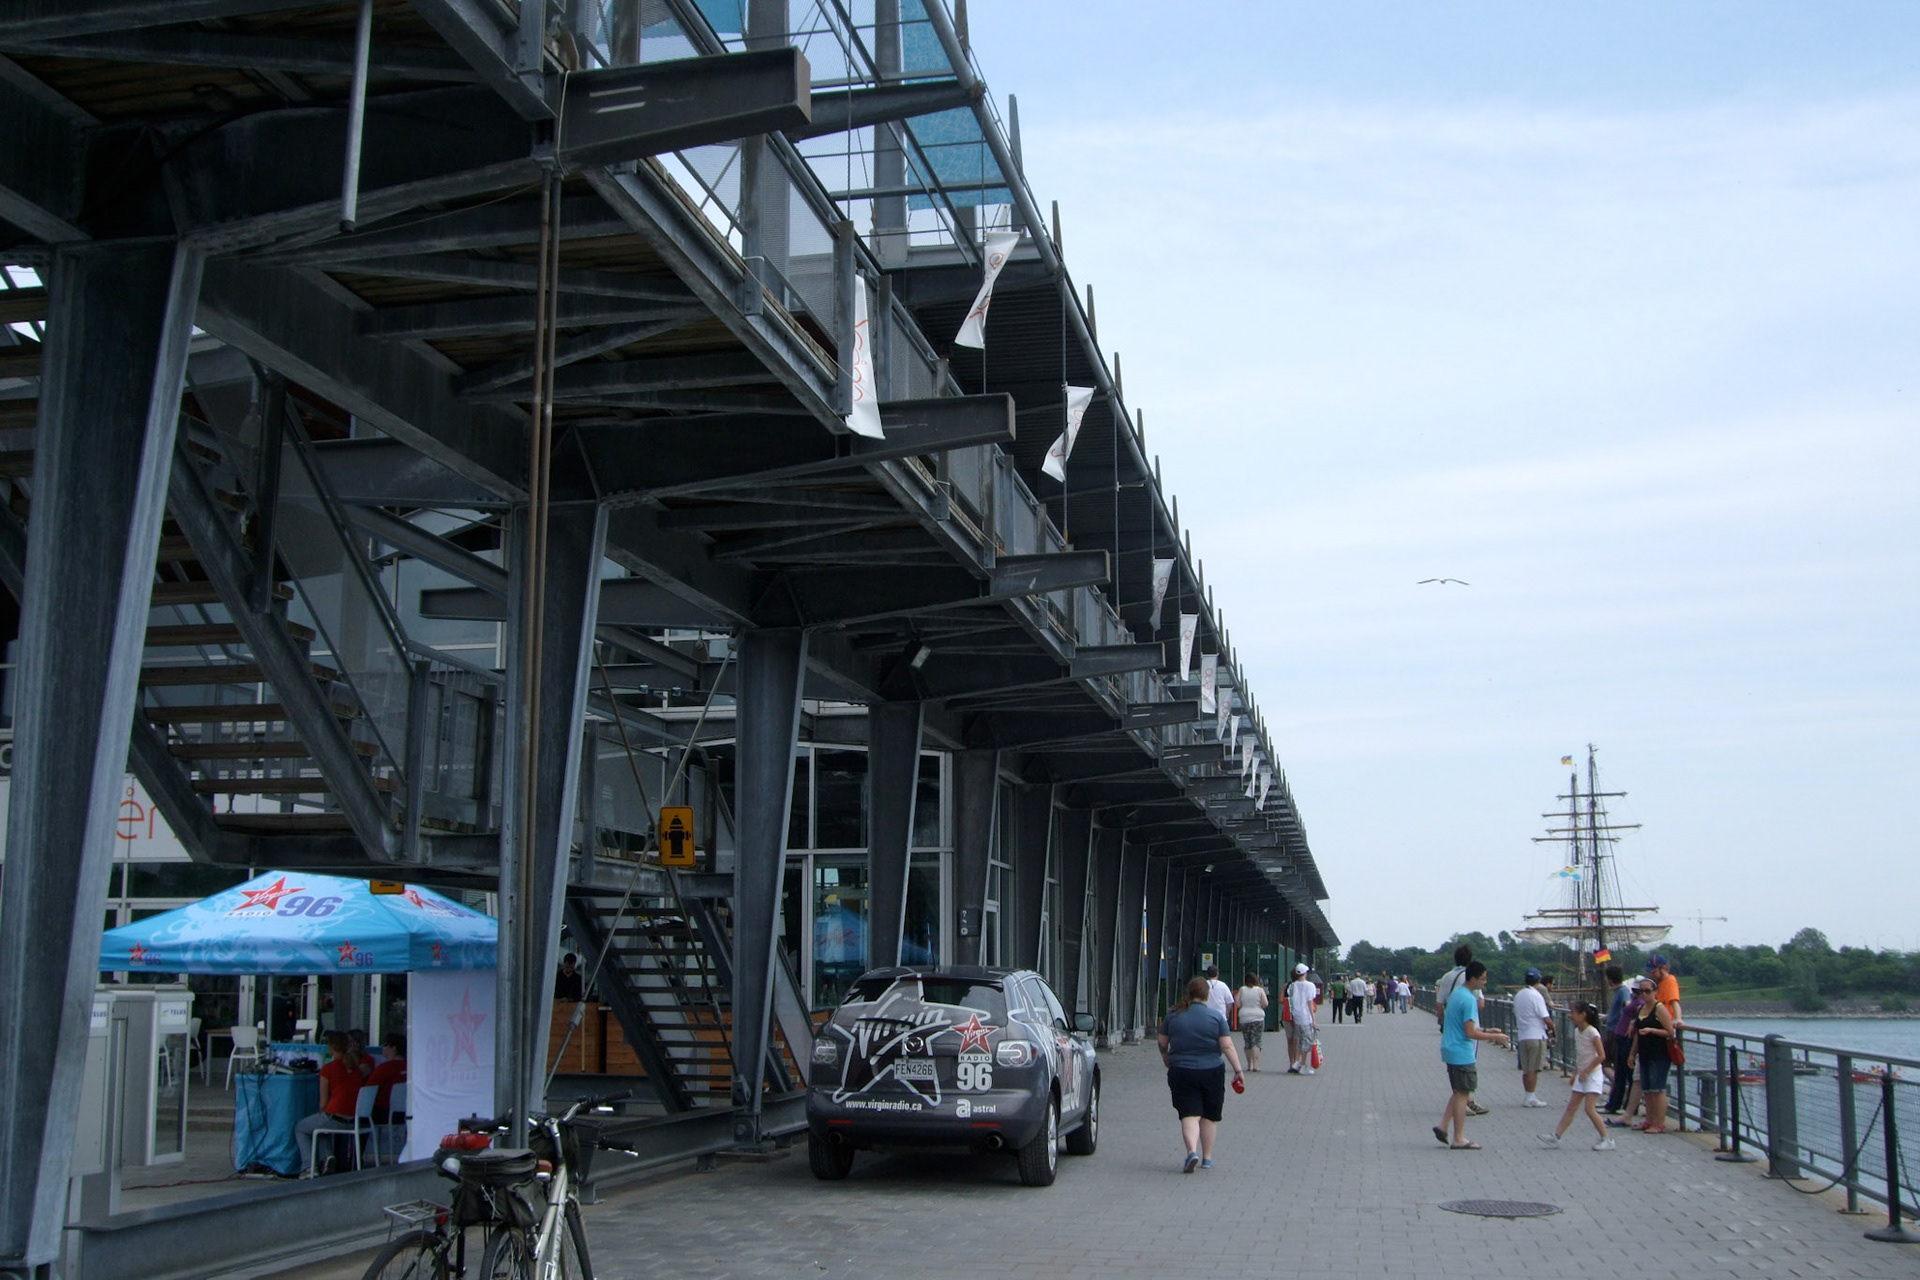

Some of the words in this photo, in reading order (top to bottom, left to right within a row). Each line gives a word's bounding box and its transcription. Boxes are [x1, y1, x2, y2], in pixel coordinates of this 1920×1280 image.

[277, 895, 343, 917] 96
[356, 952, 374, 967] 96
[851, 993, 952, 1066] Virgin
[963, 1022, 991, 1044] Virgin
[956, 1062, 993, 1091] 96
[845, 1099, 922, 1112] www.virginradio.ca
[972, 1104, 997, 1114] astral
